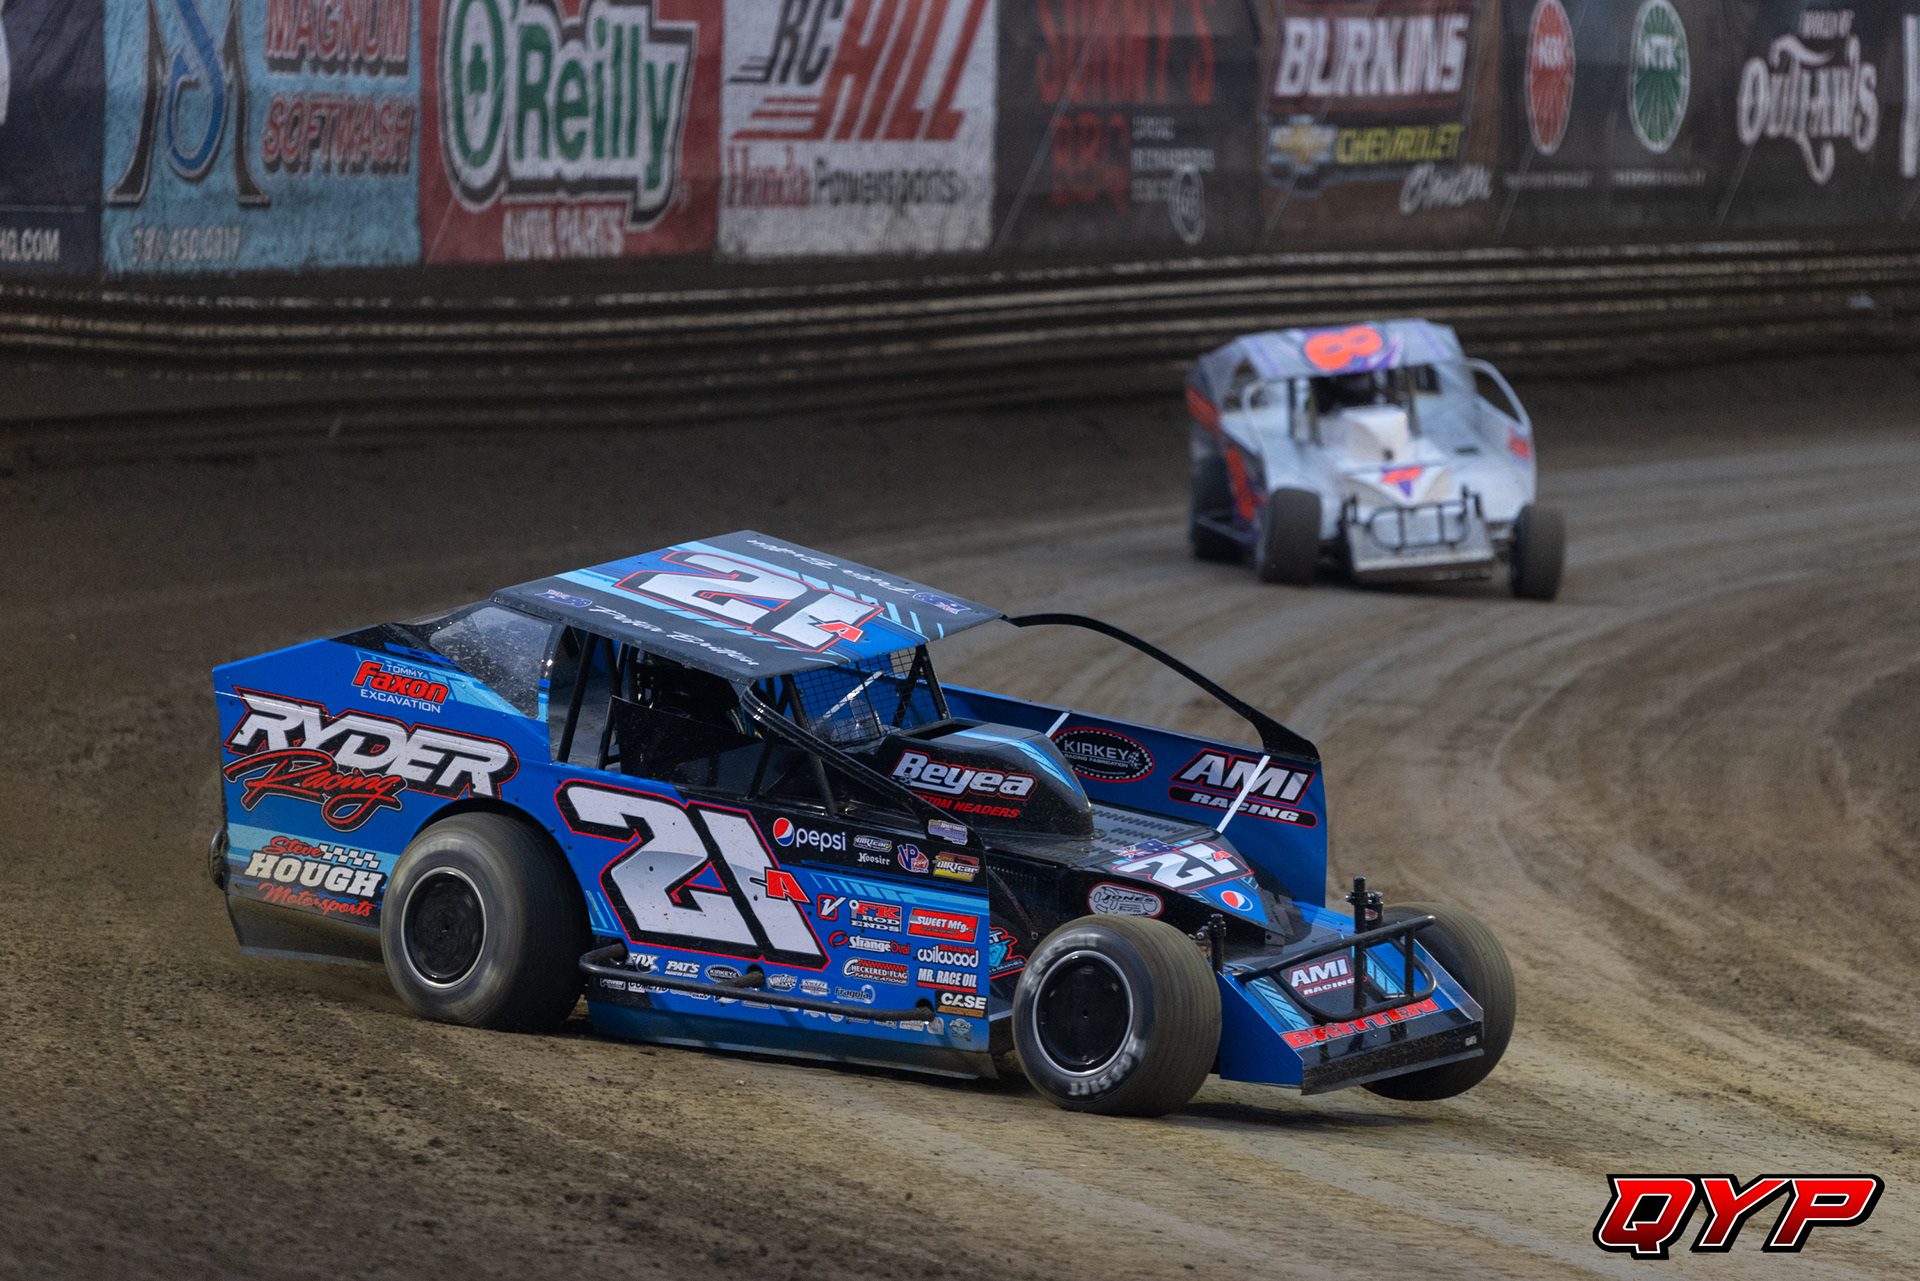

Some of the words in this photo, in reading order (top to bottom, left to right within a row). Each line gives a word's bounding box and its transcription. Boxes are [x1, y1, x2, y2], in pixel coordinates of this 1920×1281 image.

[1274, 14, 1470, 97] BURKINS
[812, 0, 988, 141] HILL
[450, 0, 677, 191] O'Reilly
[262, 93, 414, 170] SOFTWASH
[1336, 124, 1464, 164] CHEVROLET
[1305, 325, 1383, 370] 8
[353, 661, 449, 704] Faxon
[386, 664, 424, 678] TOMMY
[360, 689, 441, 714] EXCAVATION
[231, 692, 510, 797] RYDER
[1064, 739, 1129, 761] KIRKEY
[891, 751, 1035, 795] Beyea
[1064, 753, 1088, 761] RACING
[1088, 757, 1129, 769] FABRICATION
[224, 748, 402, 826] Racing
[1180, 754, 1309, 801] AMI
[953, 801, 1021, 819] HEADERS
[1190, 792, 1300, 822] RACING
[262, 836, 324, 857] Steve
[796, 828, 846, 853] pepsi
[898, 843, 919, 870] VP
[244, 851, 384, 898] HOUGH
[764, 866, 812, 903] A
[258, 882, 378, 918] Motorsports
[857, 903, 901, 920] FK
[850, 920, 900, 932] ENDS
[861, 914, 900, 925] ROD
[917, 916, 948, 929] SWEET
[665, 960, 701, 974] PAT'S
[843, 959, 888, 976] CHECKERED
[889, 970, 908, 980] FLAG
[917, 945, 979, 969] wilwood
[918, 967, 935, 983] MR.
[936, 969, 962, 985] RACE
[961, 972, 978, 988] OIL
[1290, 958, 1349, 989] AMI
[834, 986, 869, 1000] Fragola
[941, 992, 987, 1010] CASE
[1280, 998, 1441, 1048] BRITTEN
